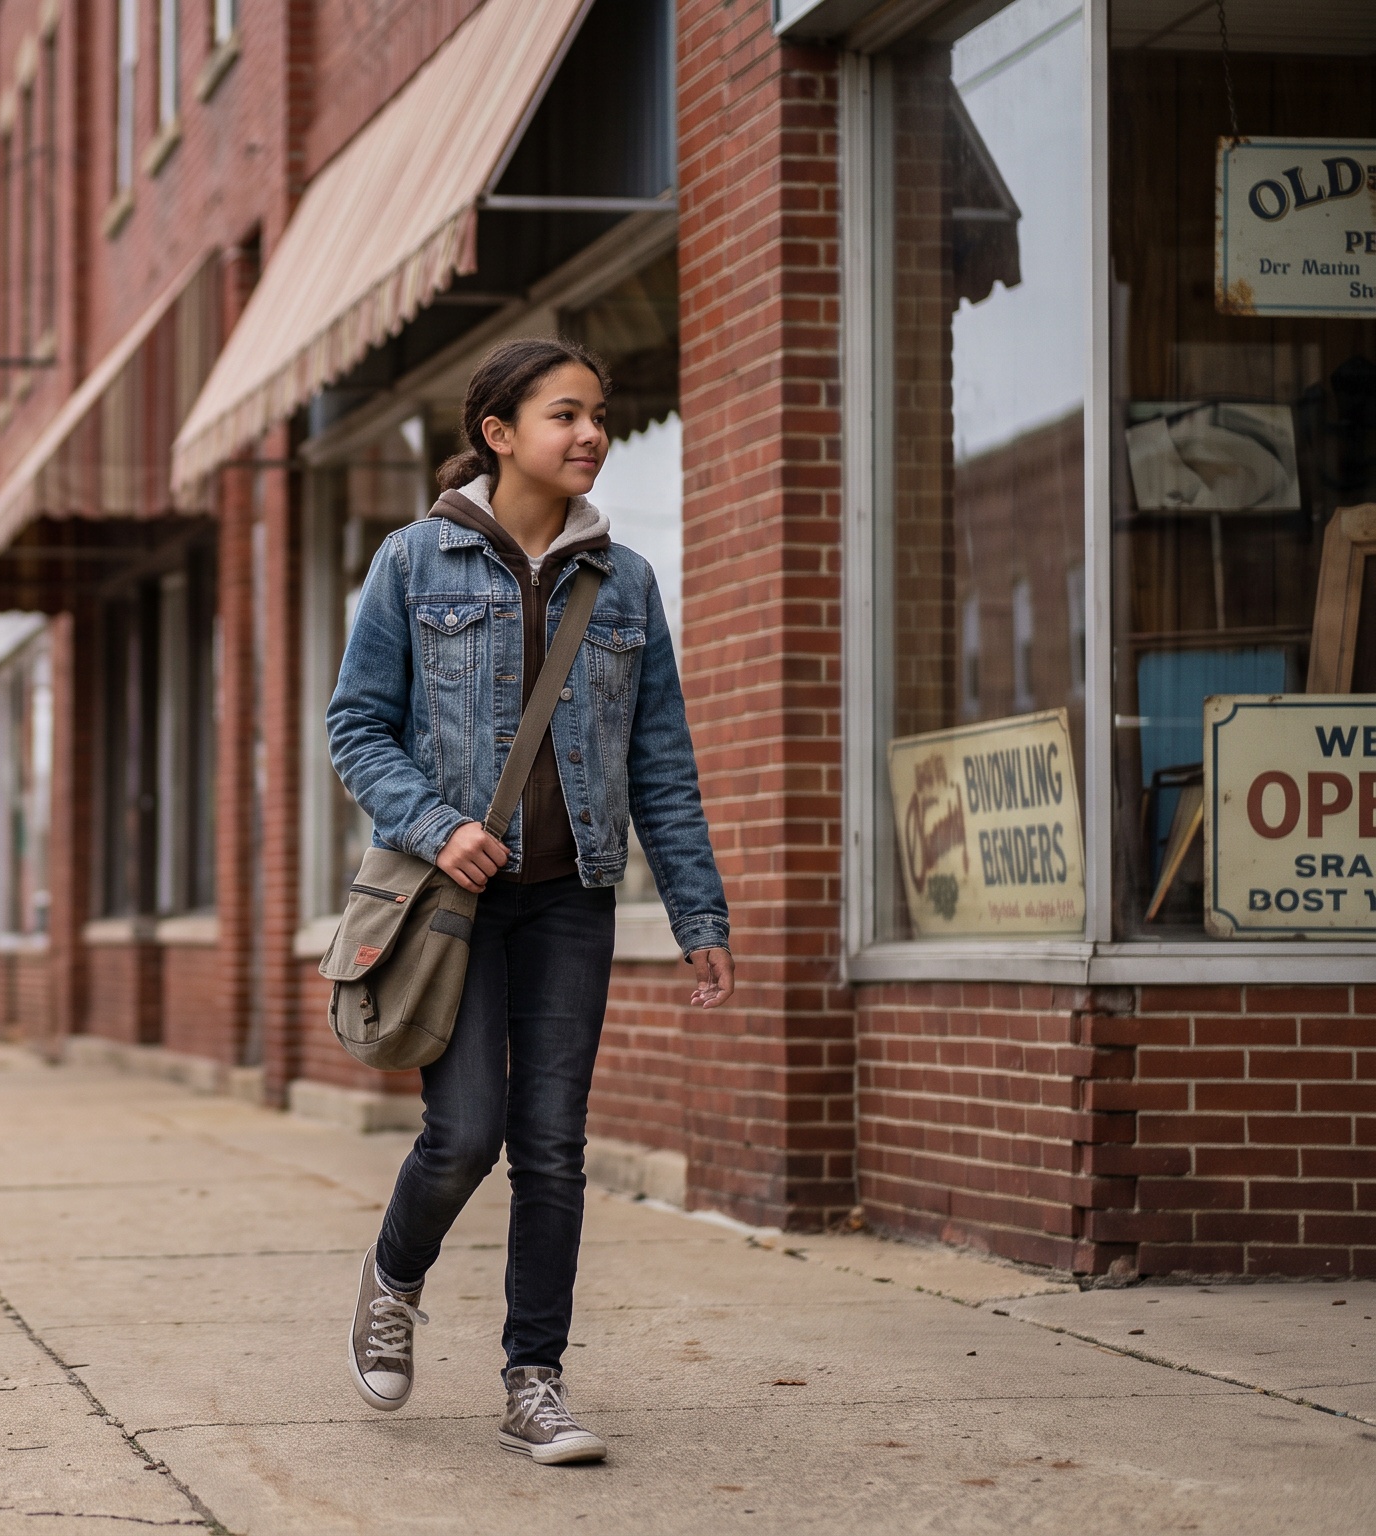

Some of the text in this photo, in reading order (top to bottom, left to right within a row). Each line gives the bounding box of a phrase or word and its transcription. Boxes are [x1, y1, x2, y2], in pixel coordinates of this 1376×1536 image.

[1248, 156, 1365, 222] OLD
[1349, 281, 1376, 298] Sh
[1247, 770, 1376, 840] OPE
[1295, 853, 1374, 878] SRA
